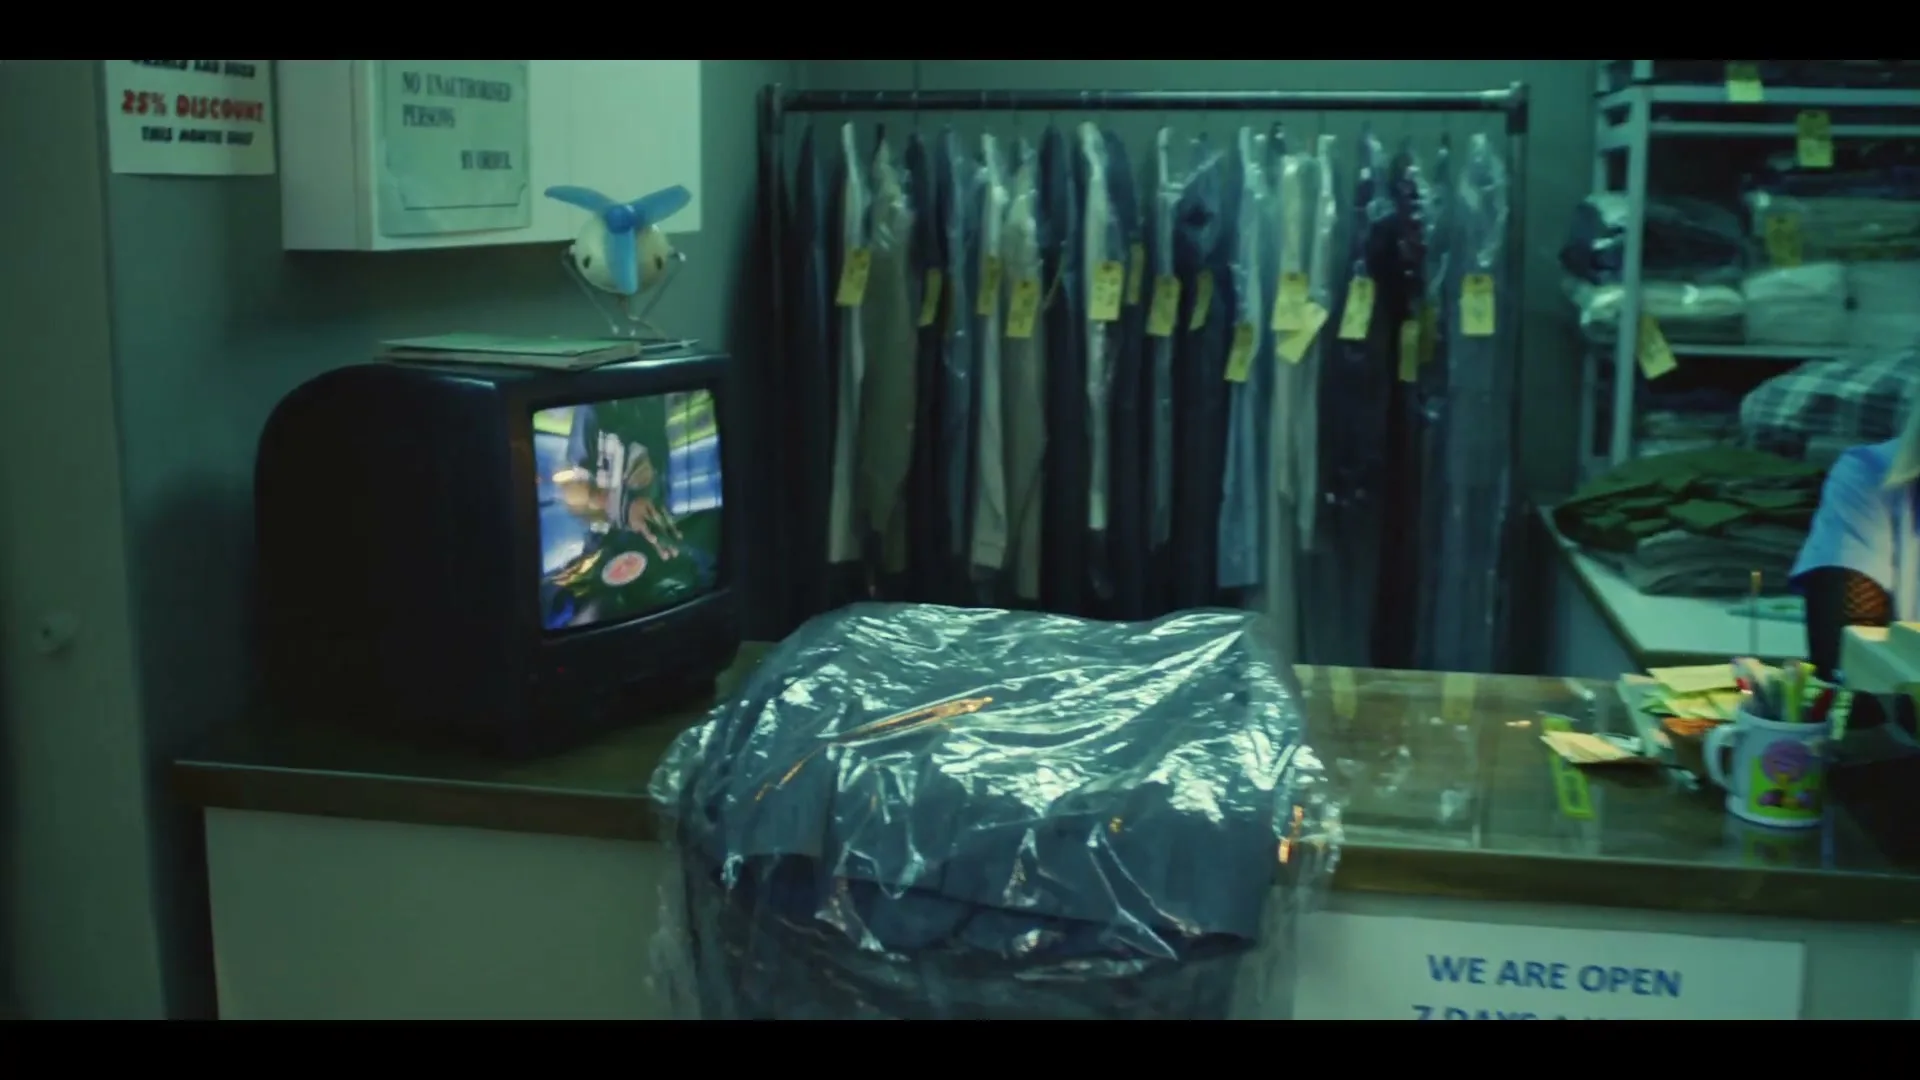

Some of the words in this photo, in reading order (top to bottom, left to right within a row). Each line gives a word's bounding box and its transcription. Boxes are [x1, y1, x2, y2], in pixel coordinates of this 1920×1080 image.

[402, 71, 421, 95] NO
[426, 73, 512, 102] UNAUTHORISED
[122, 89, 167, 116] 25%
[176, 94, 264, 122] DISCOUNT
[402, 103, 456, 128] PERSONS
[1427, 954, 1489, 985] WE
[1496, 959, 1570, 990] ARE
[1577, 964, 1684, 998] OPEN
